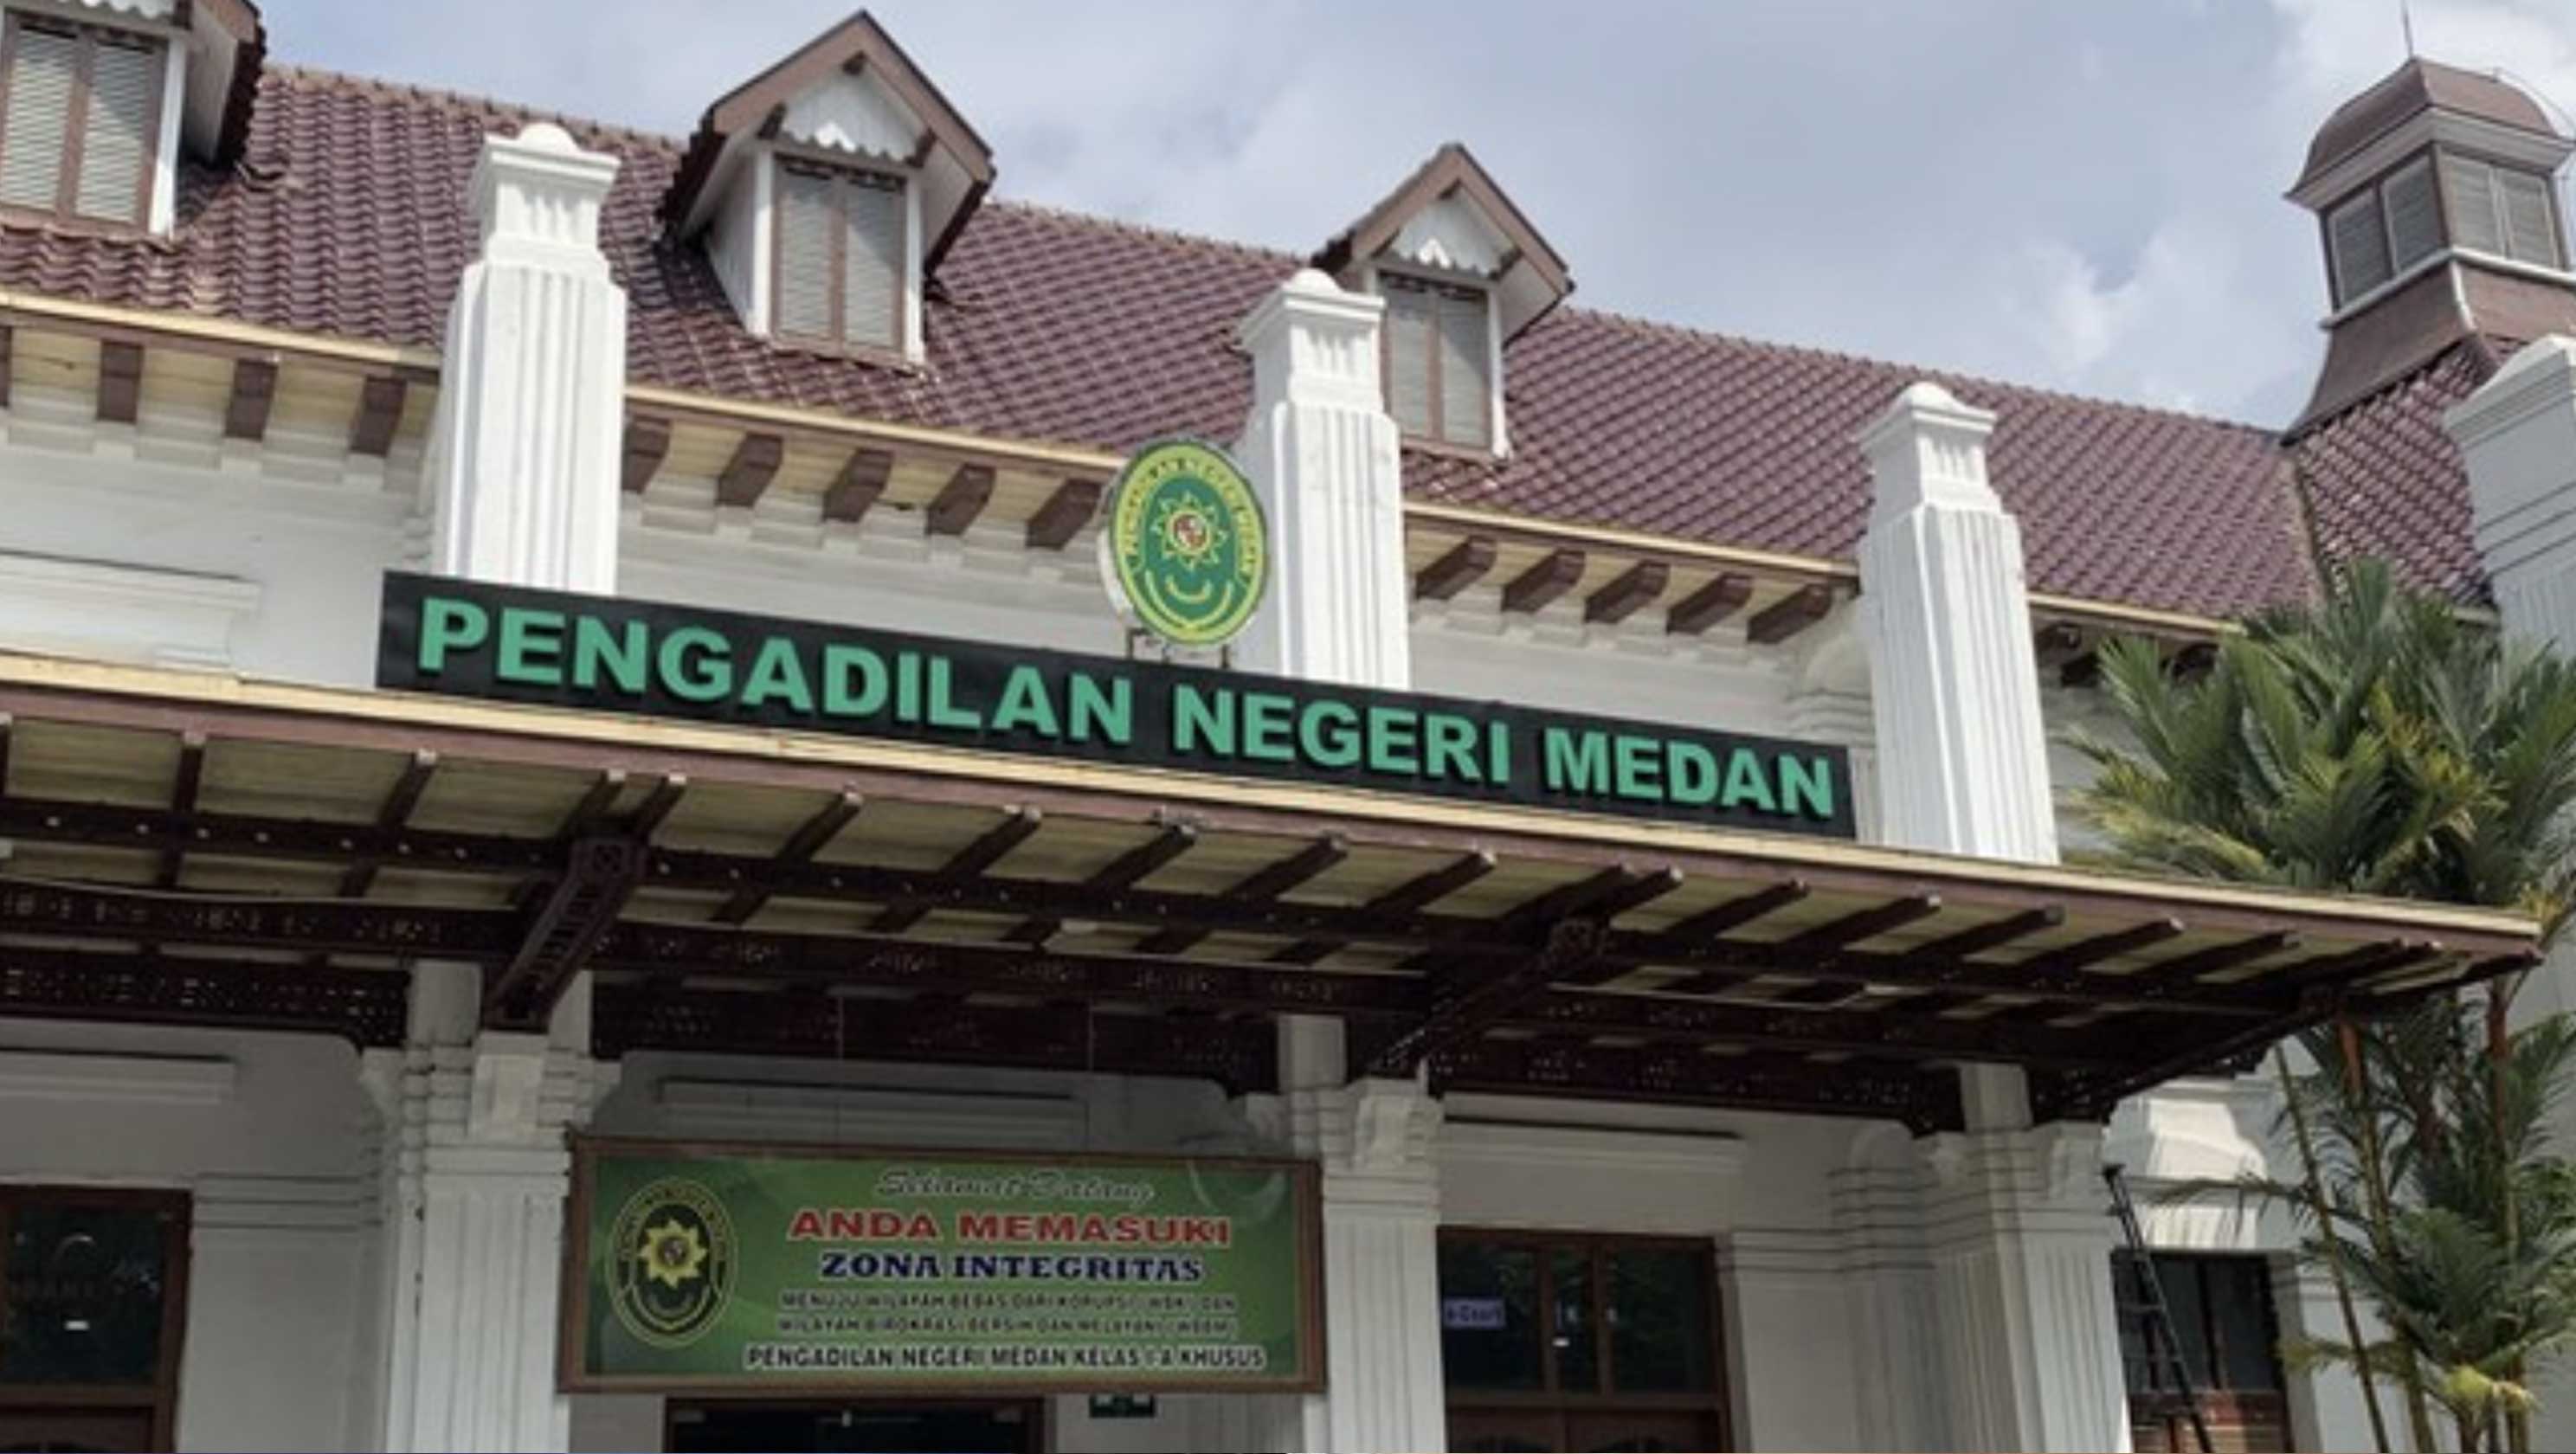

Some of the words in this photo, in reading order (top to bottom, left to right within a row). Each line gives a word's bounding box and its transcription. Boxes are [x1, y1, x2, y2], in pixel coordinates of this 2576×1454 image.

[419, 597, 1132, 743] PENGADILAN
[1174, 685, 1510, 783] NEGERI
[1545, 728, 1833, 815] MEDAN
[789, 1210, 940, 1240] ANDA
[958, 1213, 1231, 1245] MEMASUKI
[821, 1252, 940, 1279] ZONA
[953, 1254, 1203, 1282] INTEGRITAS
[782, 1293, 860, 1309] MENUJU
[866, 1293, 943, 1309] WILAYAH
[950, 1294, 1007, 1309] BEBAS
[1013, 1294, 1053, 1309] DARI
[780, 1318, 859, 1332] WILAYAH
[969, 1319, 1033, 1333] BERSIH
[1037, 1319, 1072, 1334] DAN
[747, 1346, 894, 1367] PENGADILAN
[901, 1347, 985, 1367] NEGERI
[990, 1347, 1066, 1367] MEDAN
[1073, 1347, 1138, 1367] KELAS
[1180, 1348, 1265, 1367] KHUSUS
